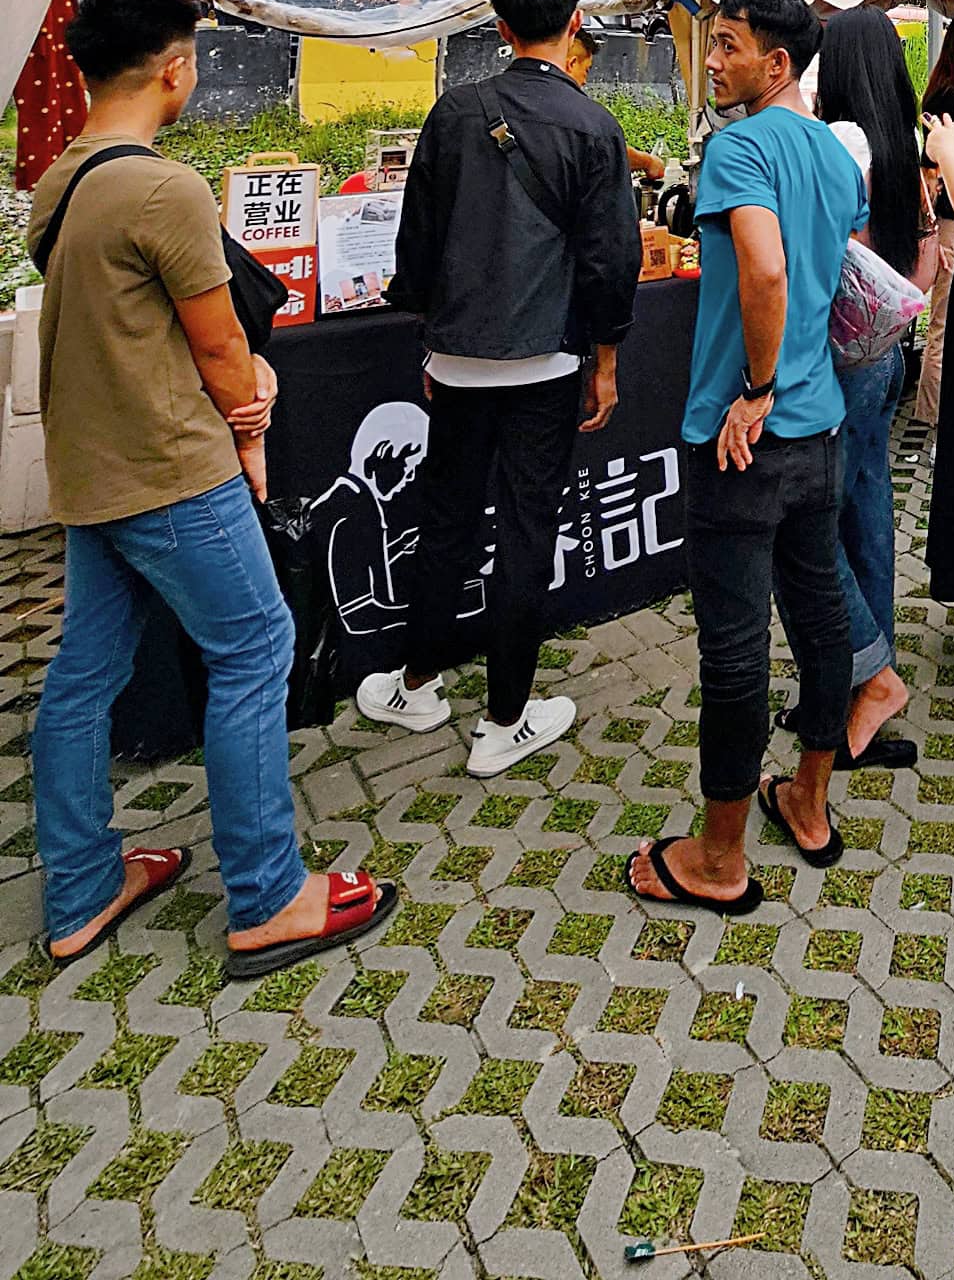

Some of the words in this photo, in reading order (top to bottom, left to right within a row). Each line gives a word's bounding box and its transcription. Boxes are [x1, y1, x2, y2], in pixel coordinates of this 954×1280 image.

[244, 171, 303, 198] 正在
[243, 200, 302, 227] 营业
[242, 225, 300, 241] COFFEE
[578, 467, 591, 501] KEE
[580, 512, 596, 578] CHOON
